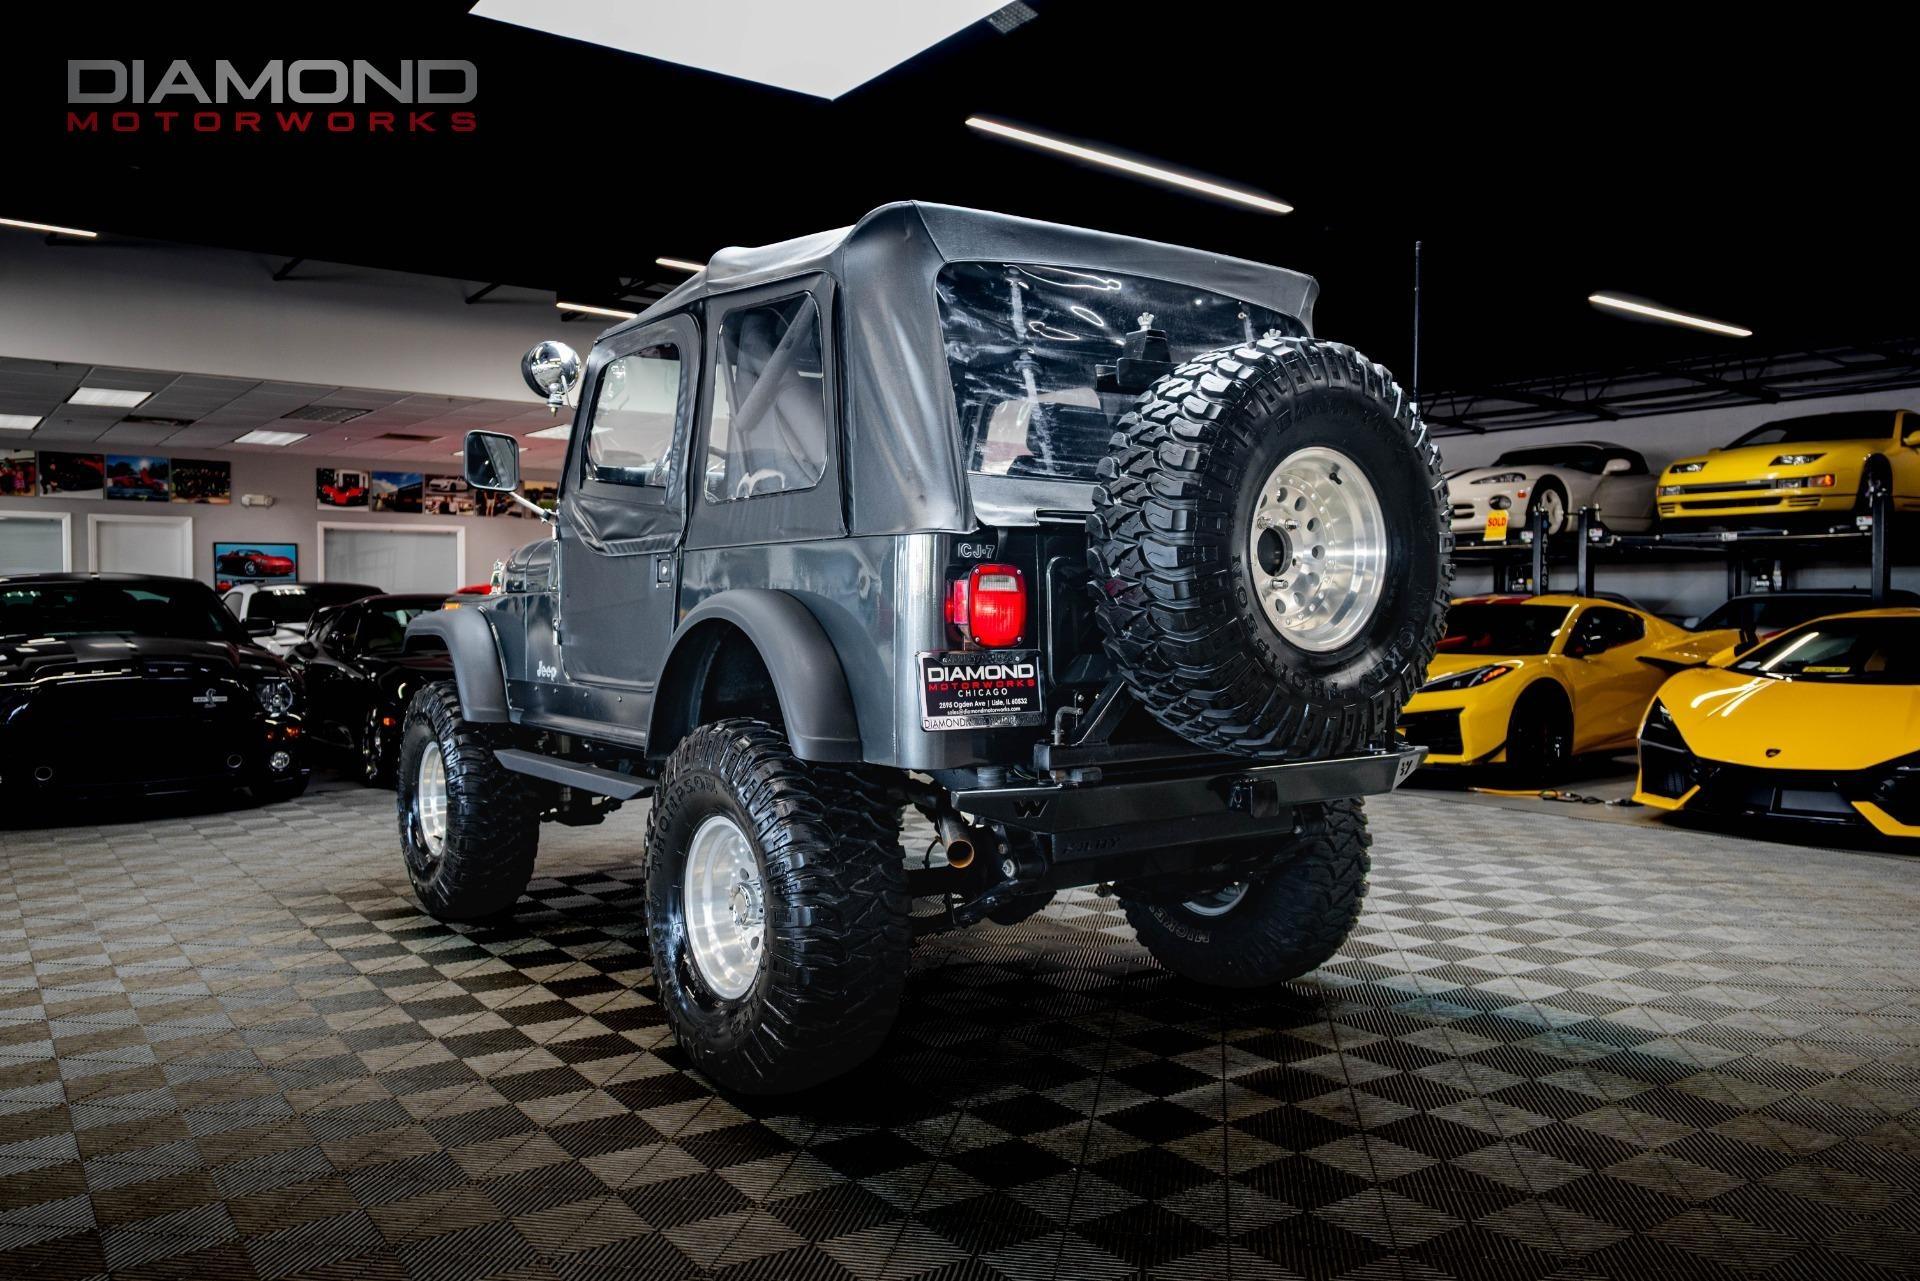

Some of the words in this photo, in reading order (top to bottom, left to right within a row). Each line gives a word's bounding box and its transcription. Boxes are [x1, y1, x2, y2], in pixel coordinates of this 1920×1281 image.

[1487, 517, 1506, 527] SOLD
[1541, 533, 1549, 587] ATLAS
[536, 660, 557, 682] Jeep
[927, 663, 1034, 682] DIAMOND
[928, 679, 1035, 692] MOTORWORKS
[957, 687, 1008, 698] CHICAGO
[953, 700, 974, 708] Ogden
